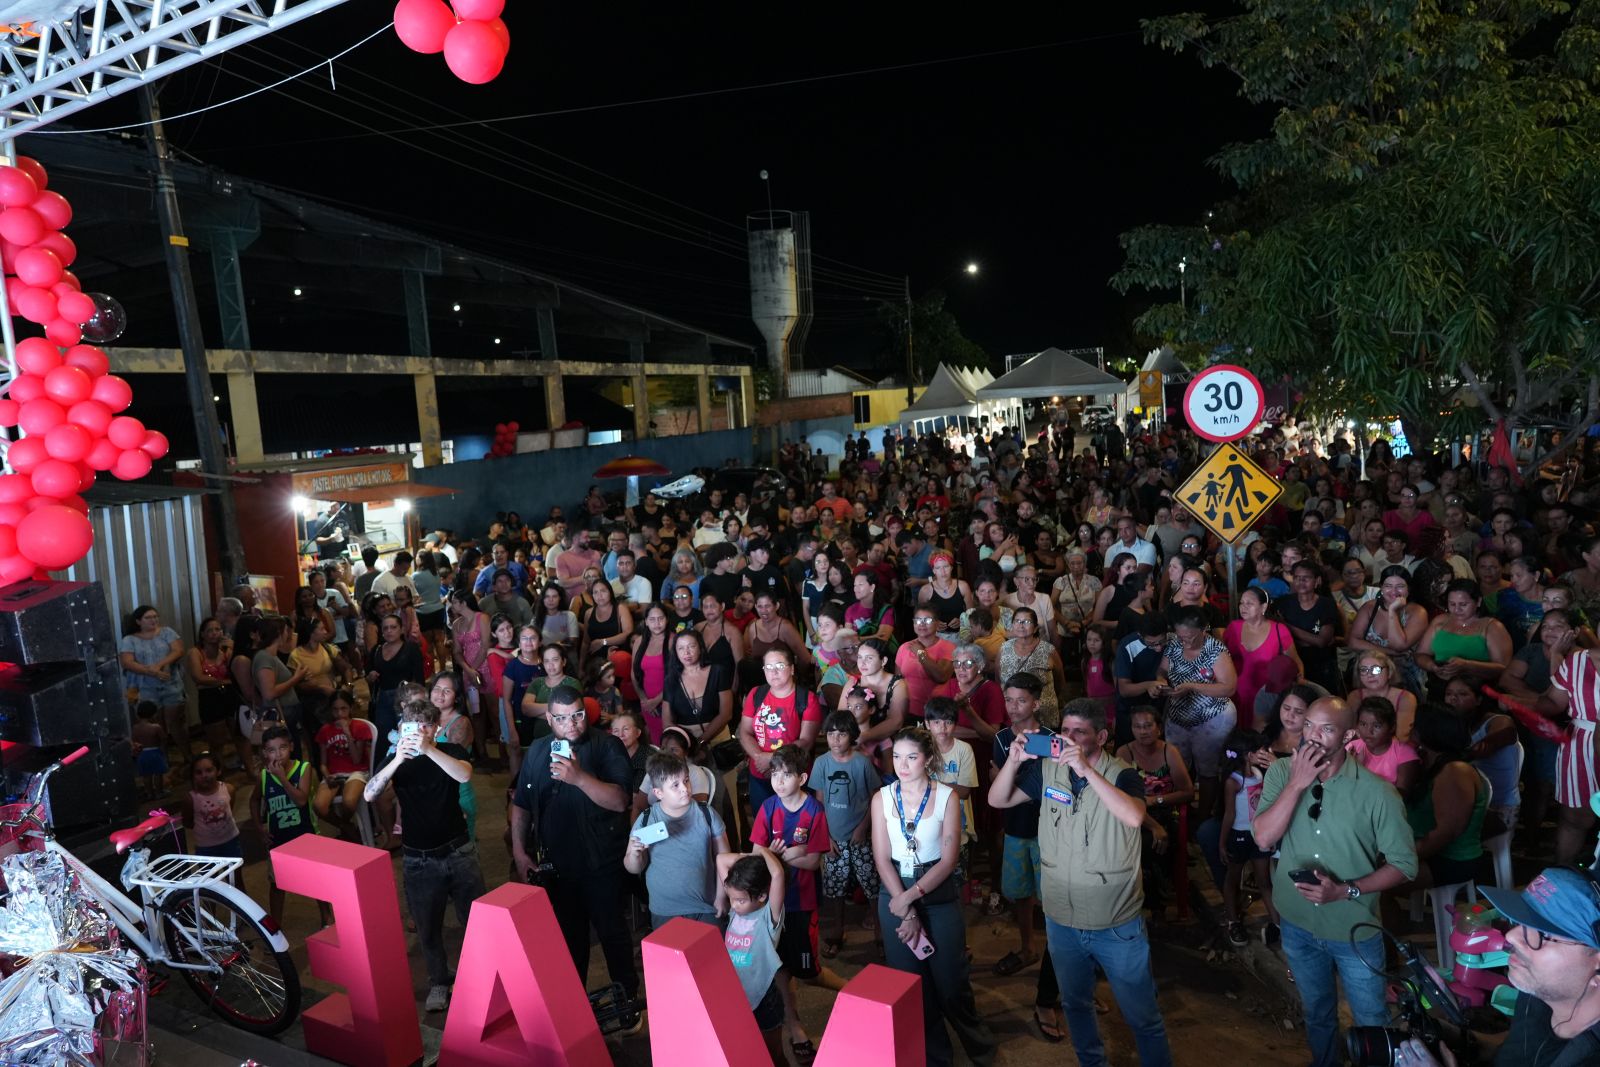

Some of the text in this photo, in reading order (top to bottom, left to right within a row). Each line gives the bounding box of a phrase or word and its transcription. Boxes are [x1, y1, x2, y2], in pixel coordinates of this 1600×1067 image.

[1203, 381, 1243, 413] 30
[1213, 413, 1240, 425] km/h
[275, 808, 302, 829] 23
